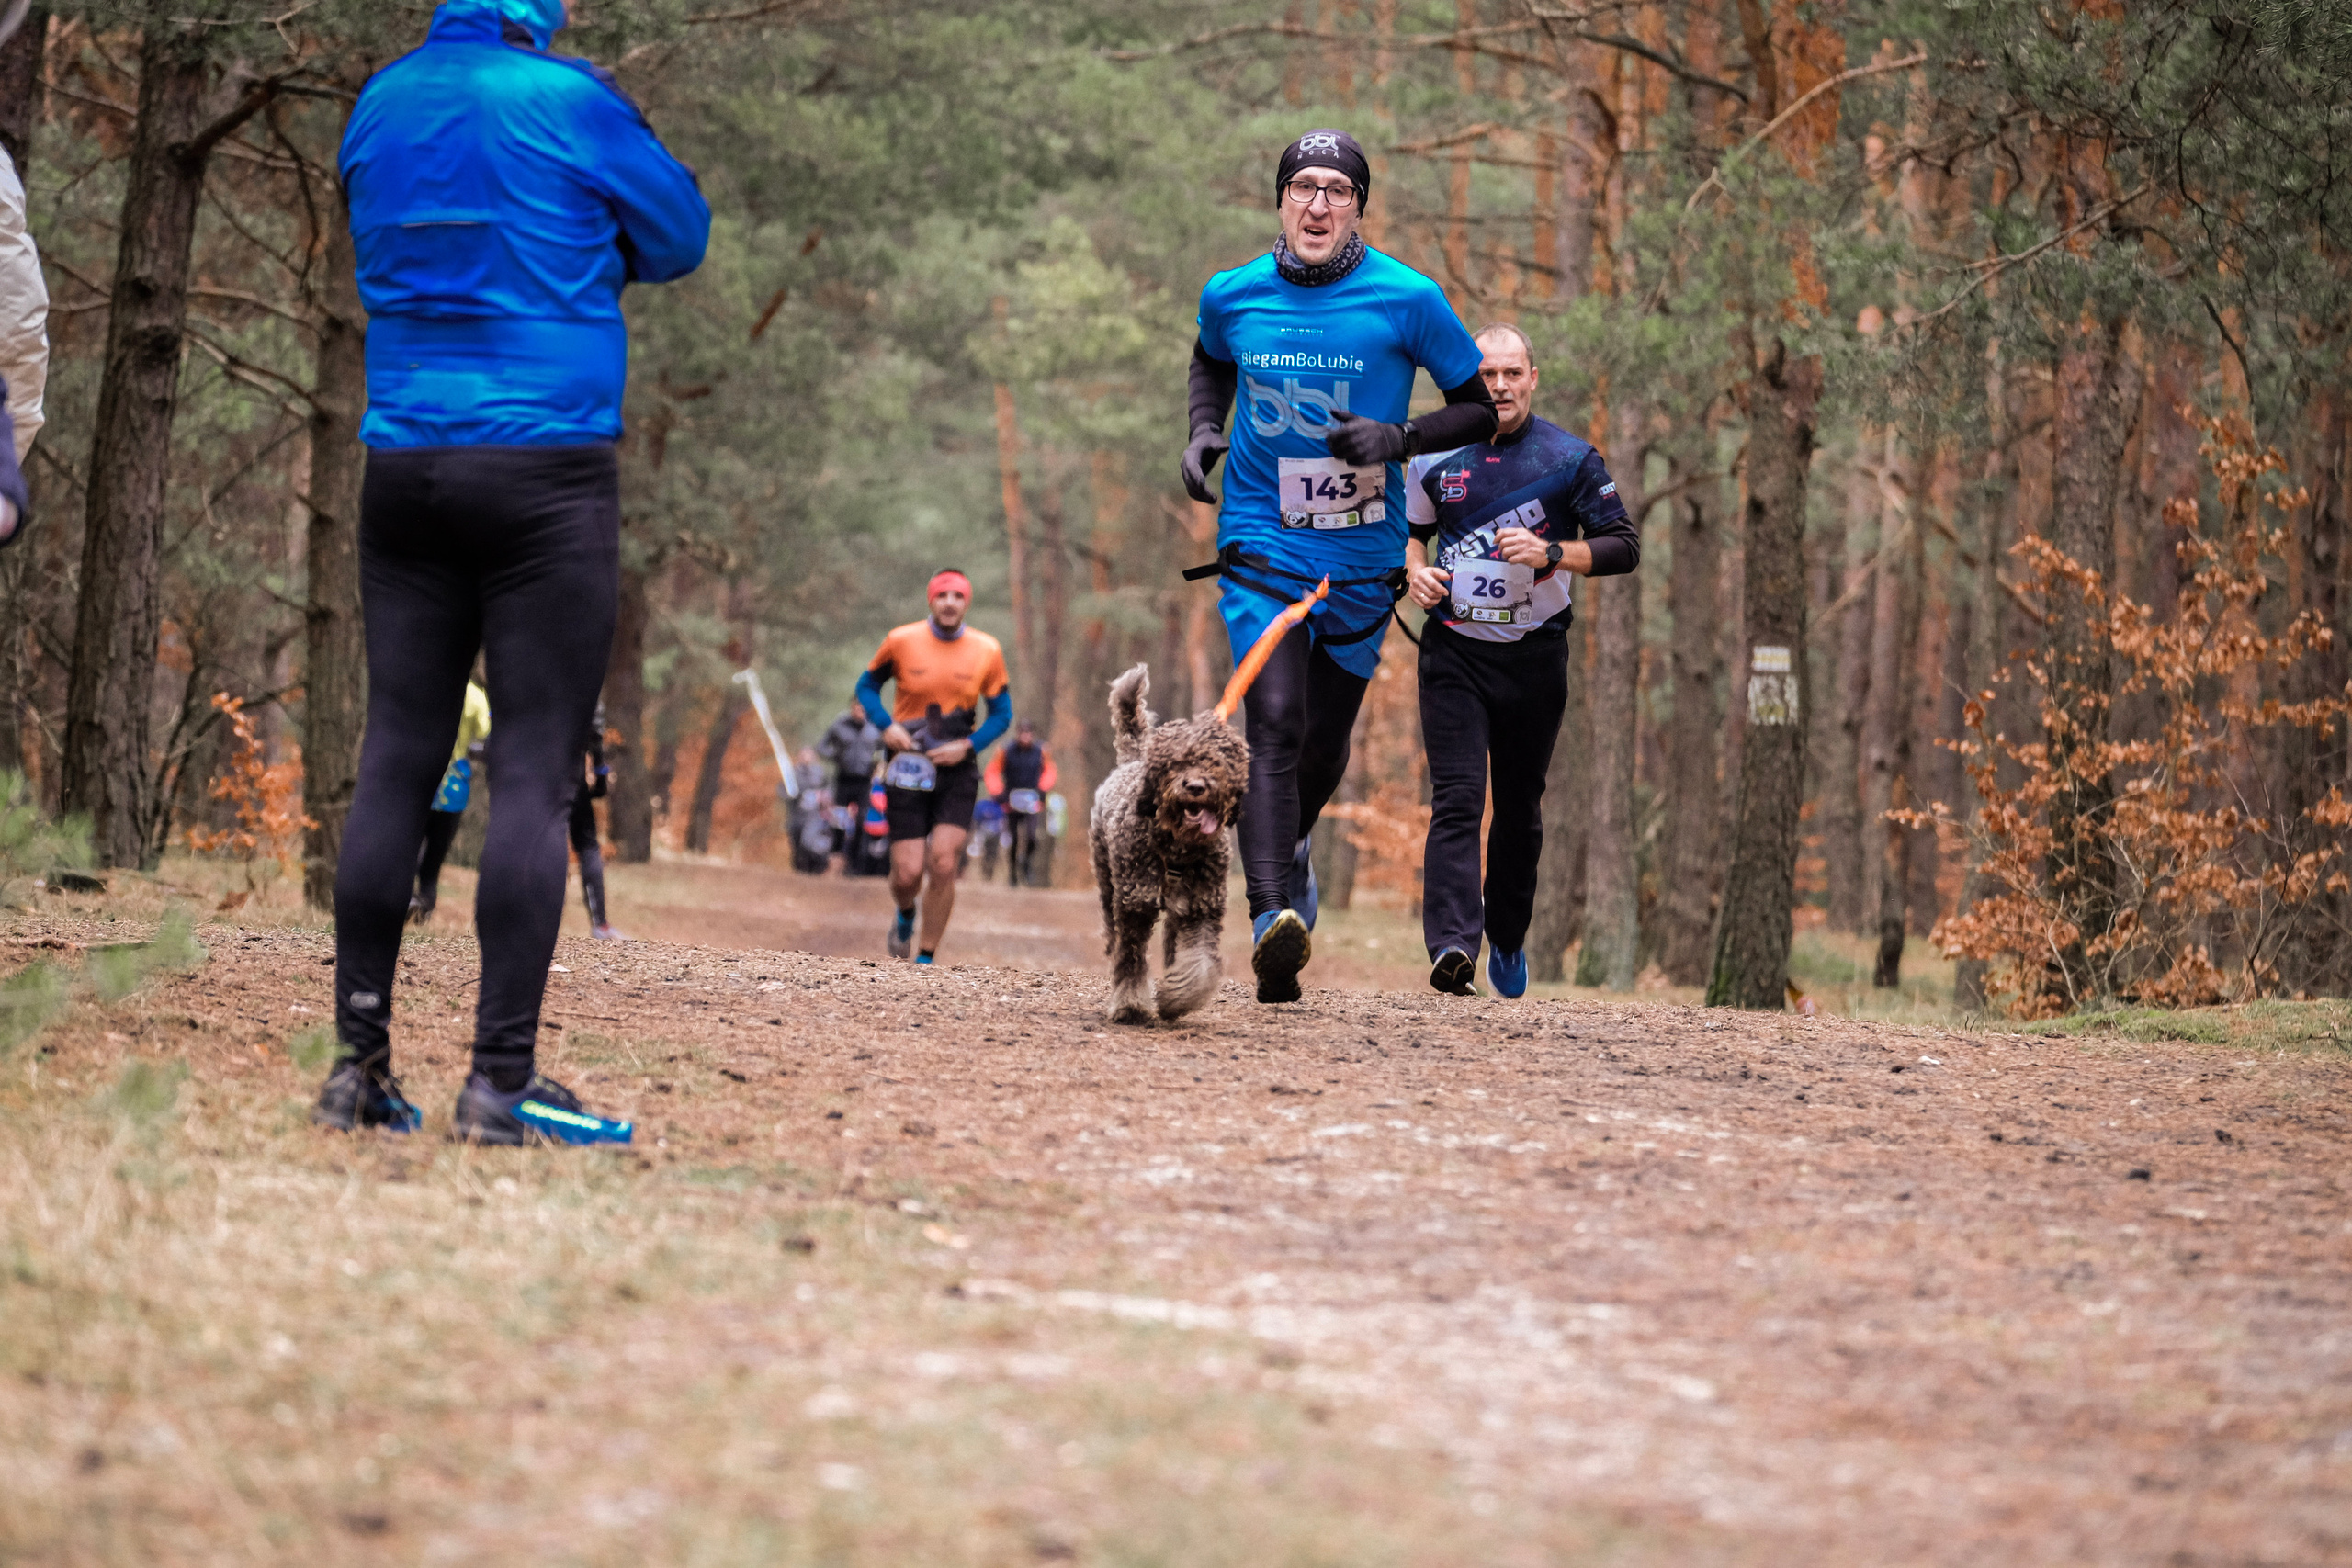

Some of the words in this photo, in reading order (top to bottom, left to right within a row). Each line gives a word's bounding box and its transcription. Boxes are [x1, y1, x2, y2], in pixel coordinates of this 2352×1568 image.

[1241, 350, 1363, 373] BiegamBoLubię
[1300, 472, 1358, 501] 143
[1472, 576, 1507, 599] 26
